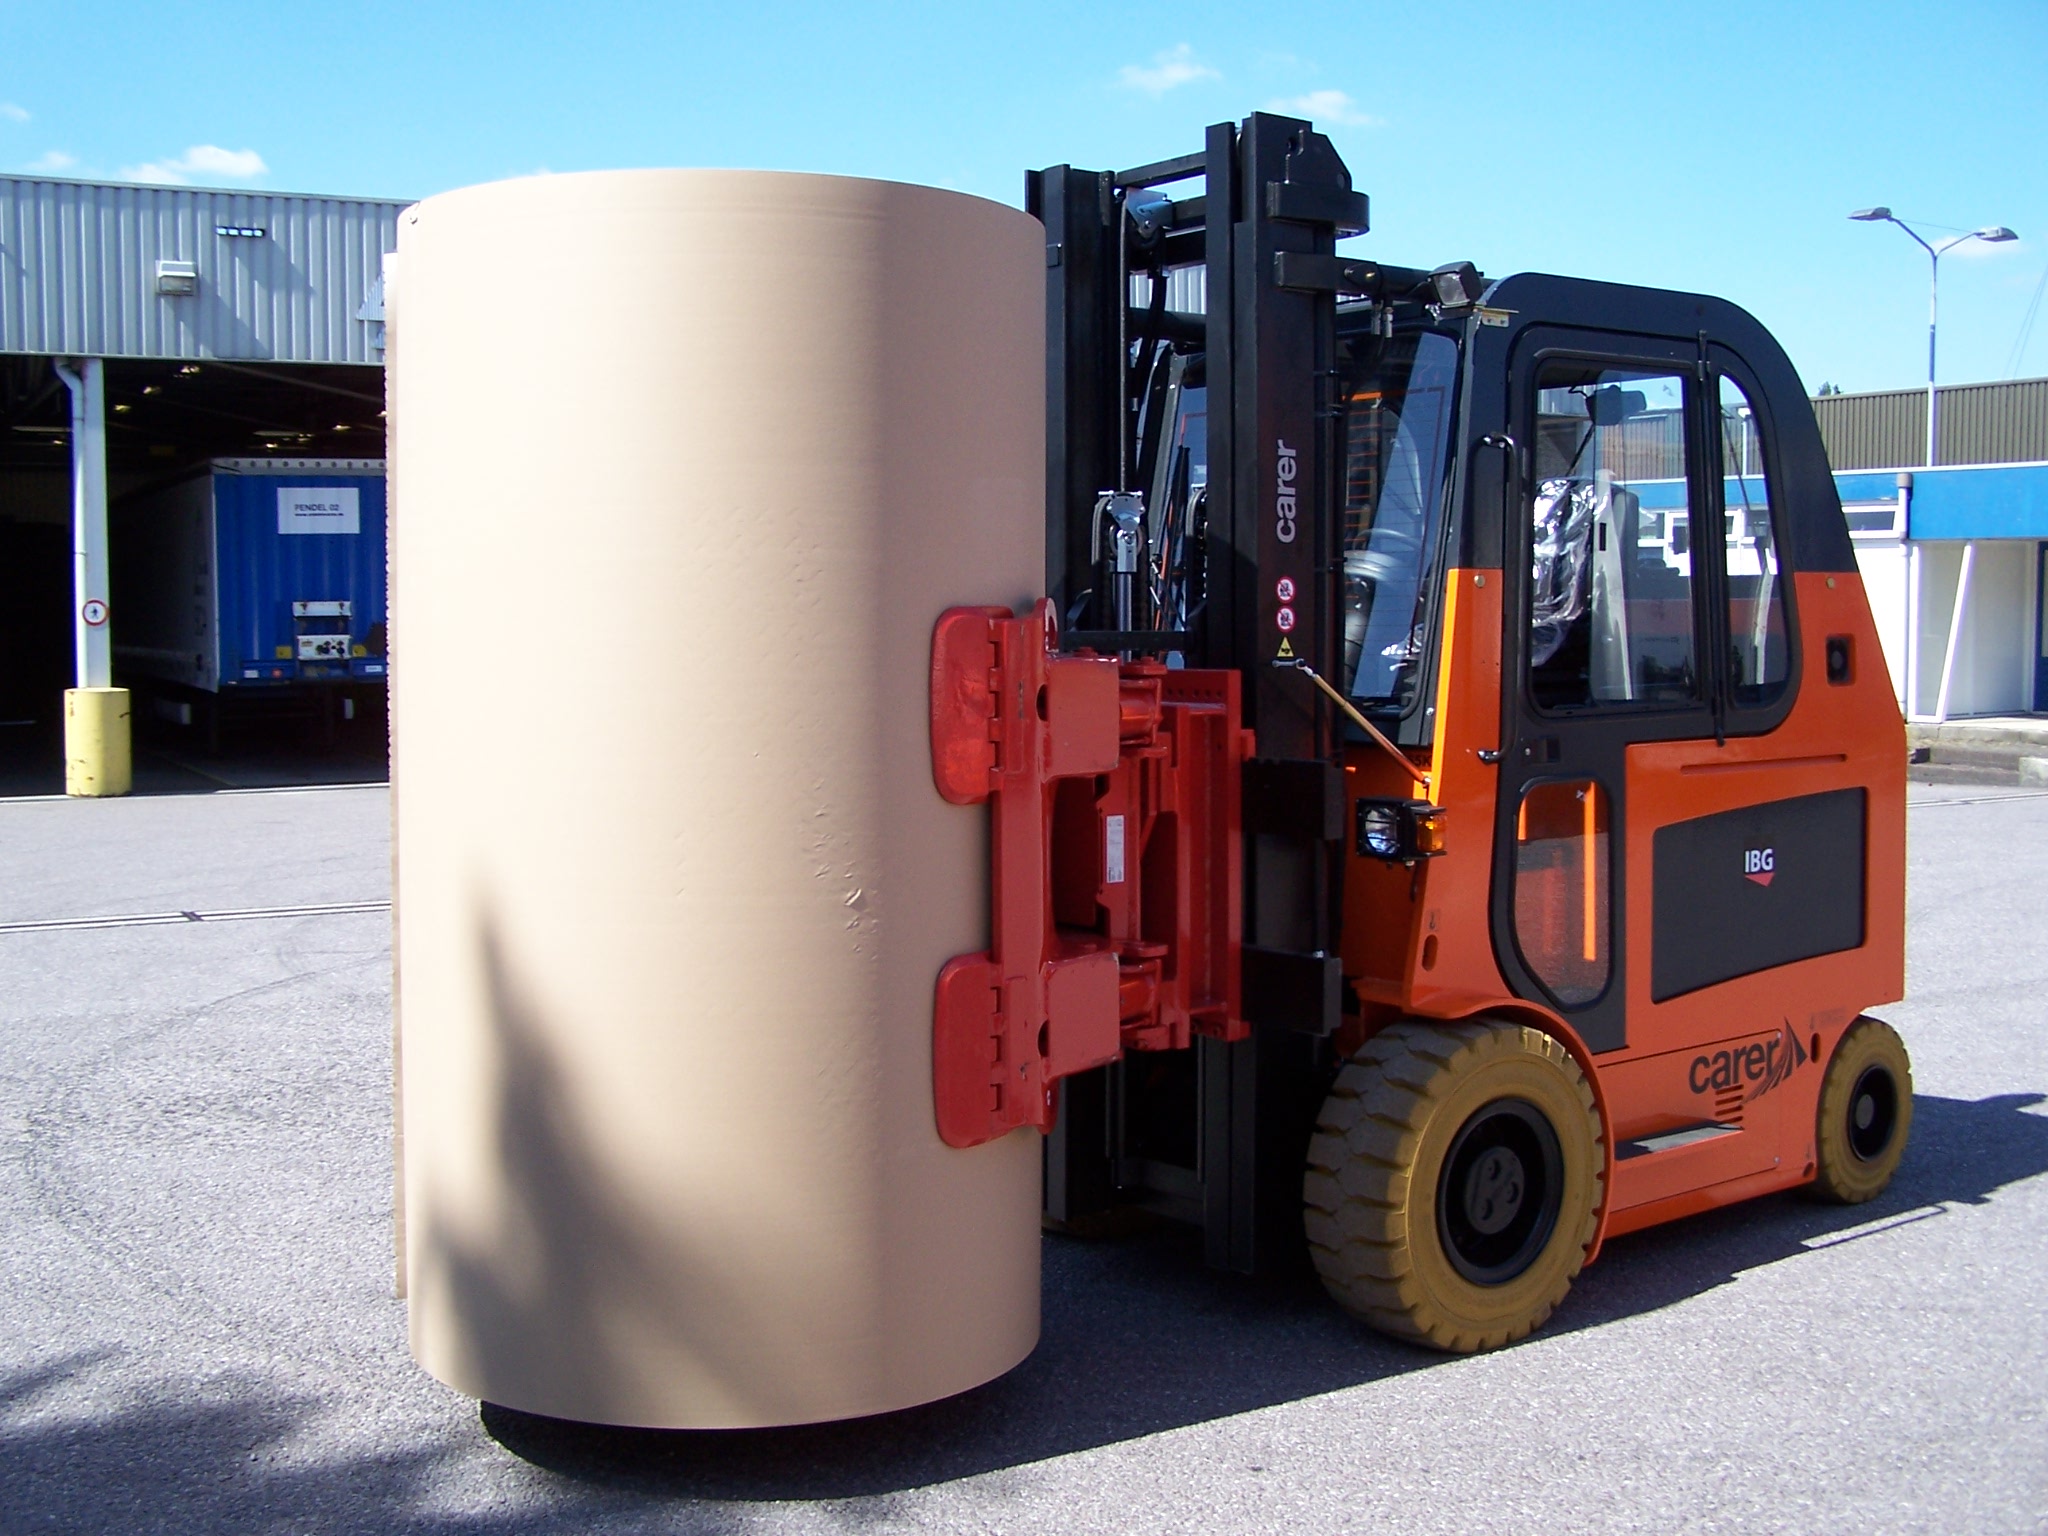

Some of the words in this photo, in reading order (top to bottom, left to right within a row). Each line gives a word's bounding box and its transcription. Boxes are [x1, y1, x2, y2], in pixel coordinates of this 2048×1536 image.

[294, 503, 328, 512] PENDEL
[1276, 438, 1297, 544] carer
[1744, 848, 1774, 873] IBG
[1688, 1037, 1780, 1095] carer
